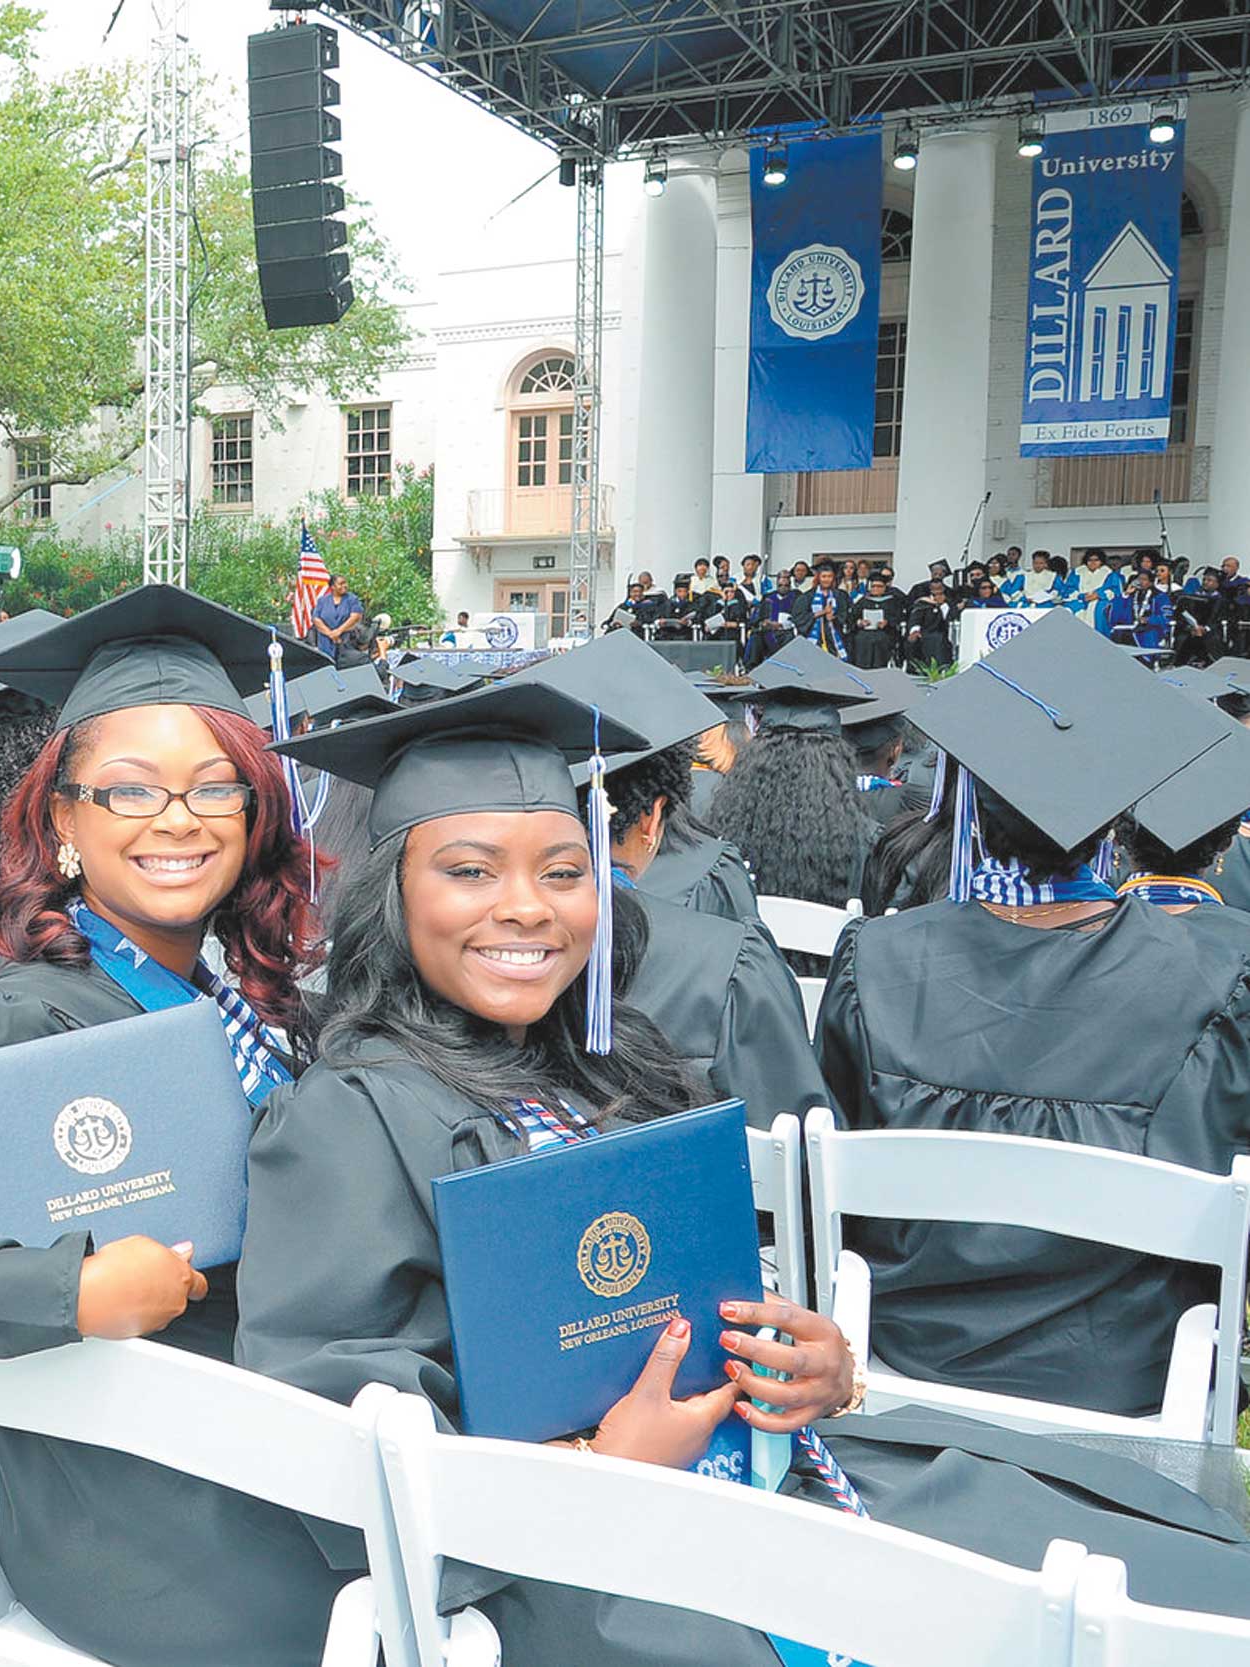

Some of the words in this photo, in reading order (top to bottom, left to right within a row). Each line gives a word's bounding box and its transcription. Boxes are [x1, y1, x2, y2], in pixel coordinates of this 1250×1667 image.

[1087, 106, 1132, 126] 1869
[1040, 149, 1175, 178] University
[777, 260, 805, 303] DILLARD
[808, 254, 854, 298] UNIVERSITY
[1029, 187, 1073, 404] DILLARD
[786, 310, 844, 330] LOUISIANA
[1035, 426, 1057, 441] Ex
[1062, 424, 1099, 440] Fide
[1104, 422, 1155, 438] Fortis
[46, 1188, 100, 1212] DILLARD
[100, 1169, 172, 1198] UNIVERSITY
[49, 1208, 74, 1223] NEW
[74, 1196, 124, 1217] ORLEANS,
[123, 1182, 176, 1204] LOUISIANA
[558, 1314, 611, 1339] DILLARD
[612, 1293, 680, 1320] UNIVERSITY
[559, 1336, 583, 1351] NEW
[584, 1325, 630, 1344] ORLEANS,
[631, 1309, 682, 1331] LOUISIANA
